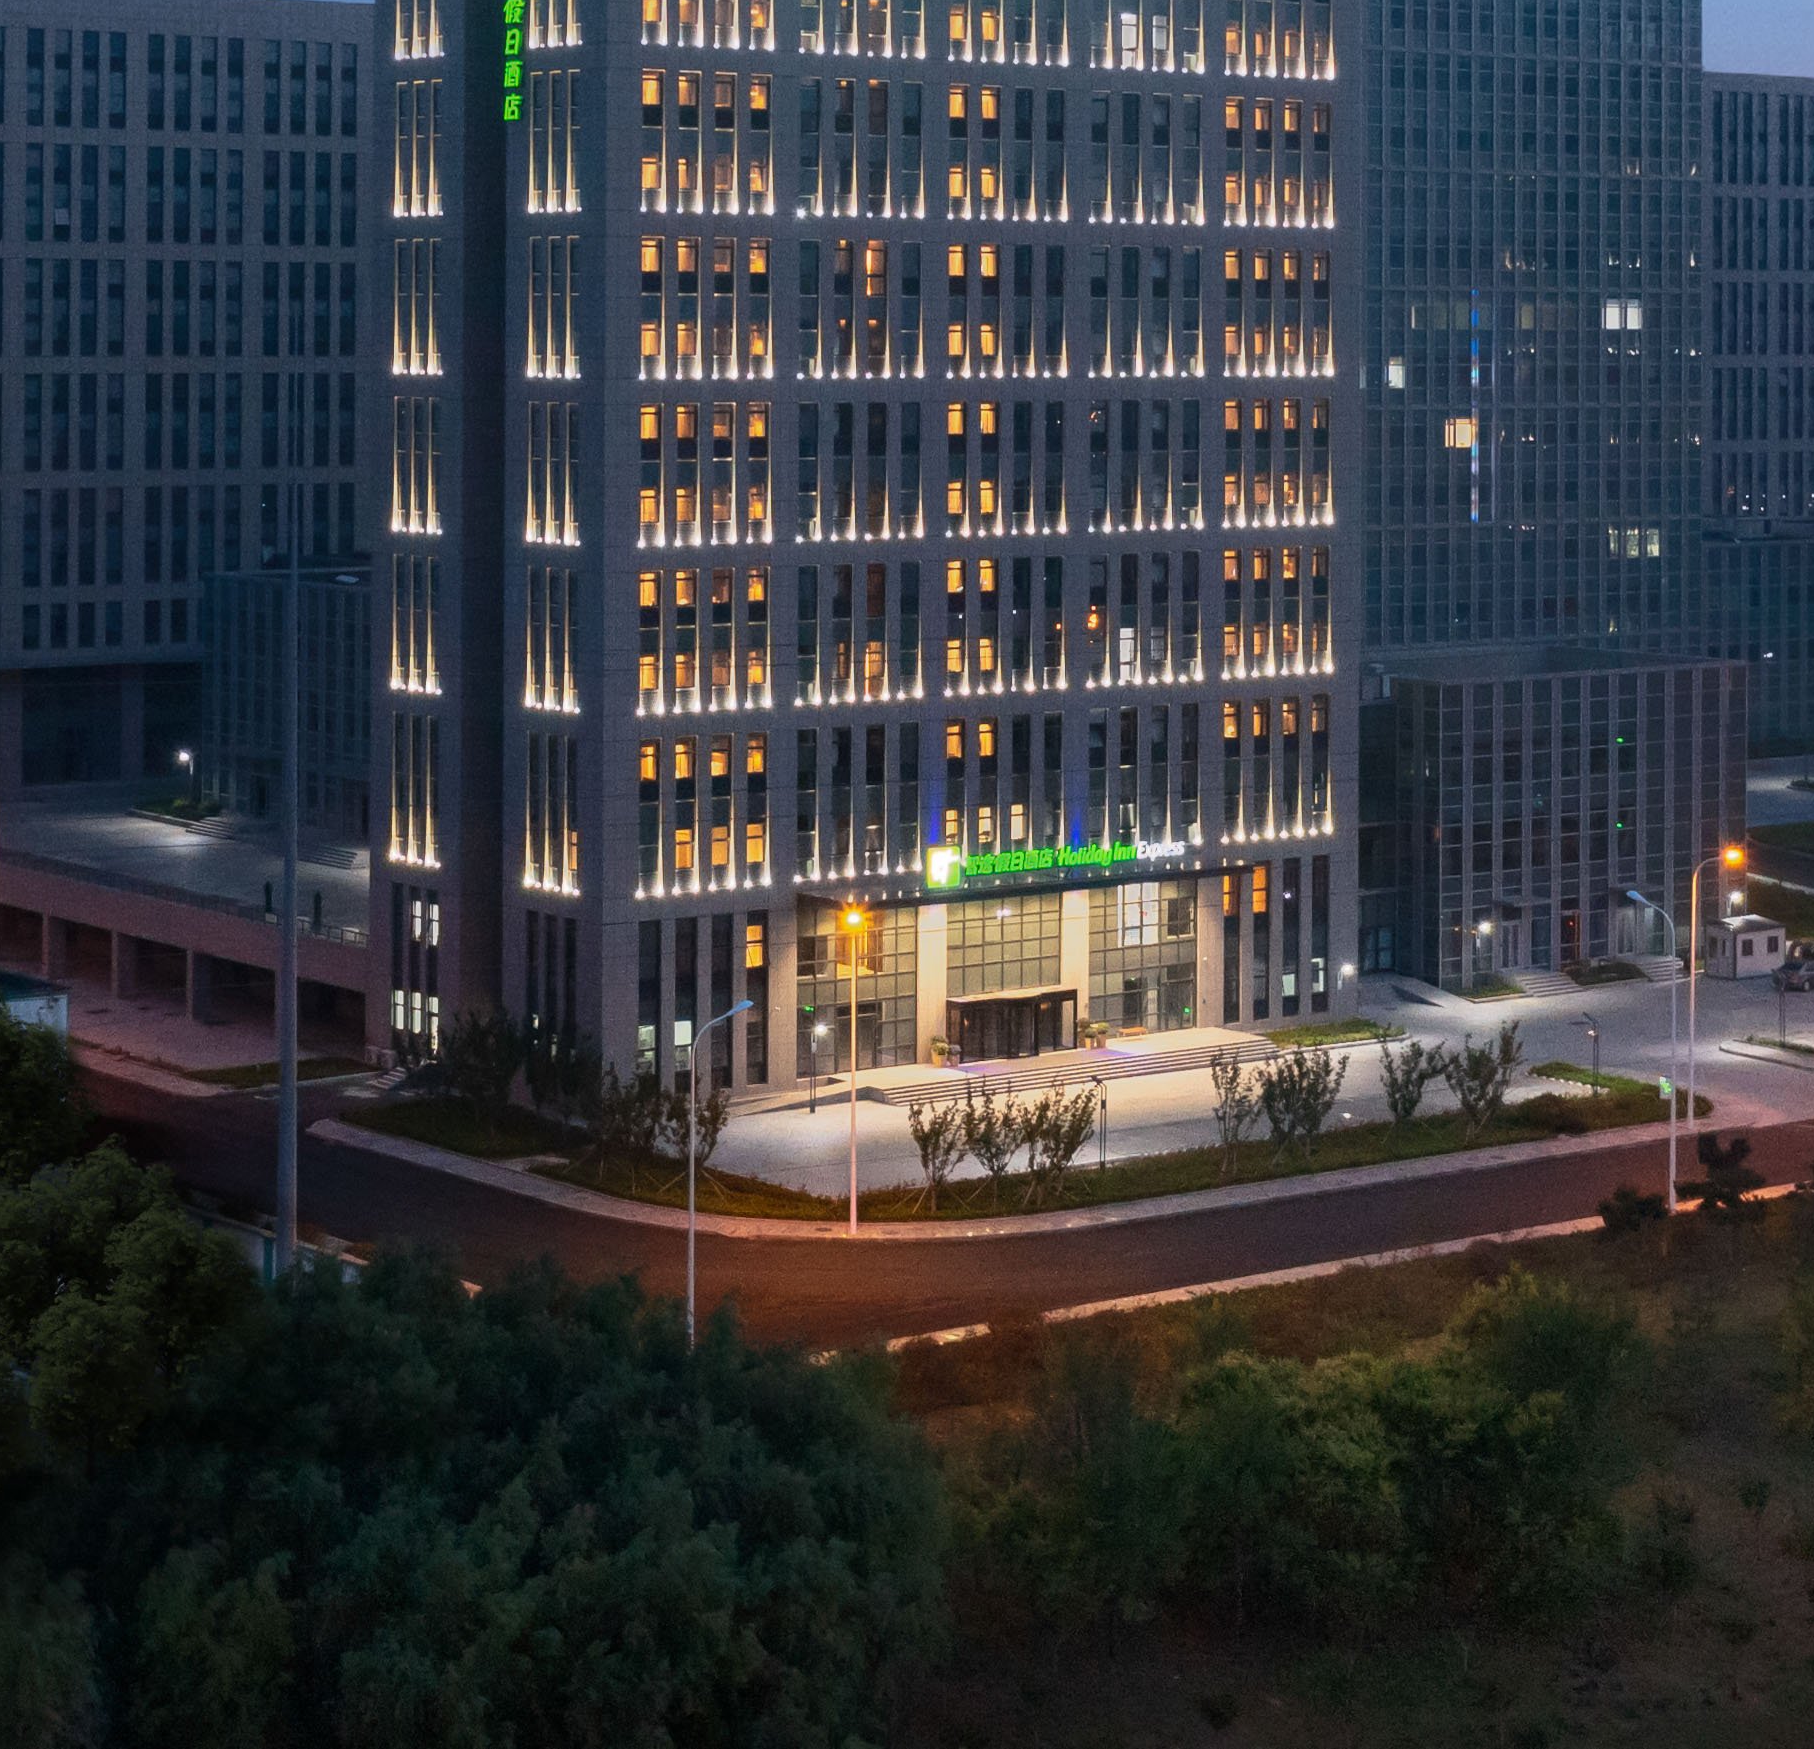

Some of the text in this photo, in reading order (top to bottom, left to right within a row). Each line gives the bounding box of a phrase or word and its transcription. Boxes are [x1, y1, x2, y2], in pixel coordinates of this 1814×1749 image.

[1057, 843, 1112, 867] Holiday
[1113, 841, 1137, 861] Inn
[1136, 840, 1186, 862] Express
